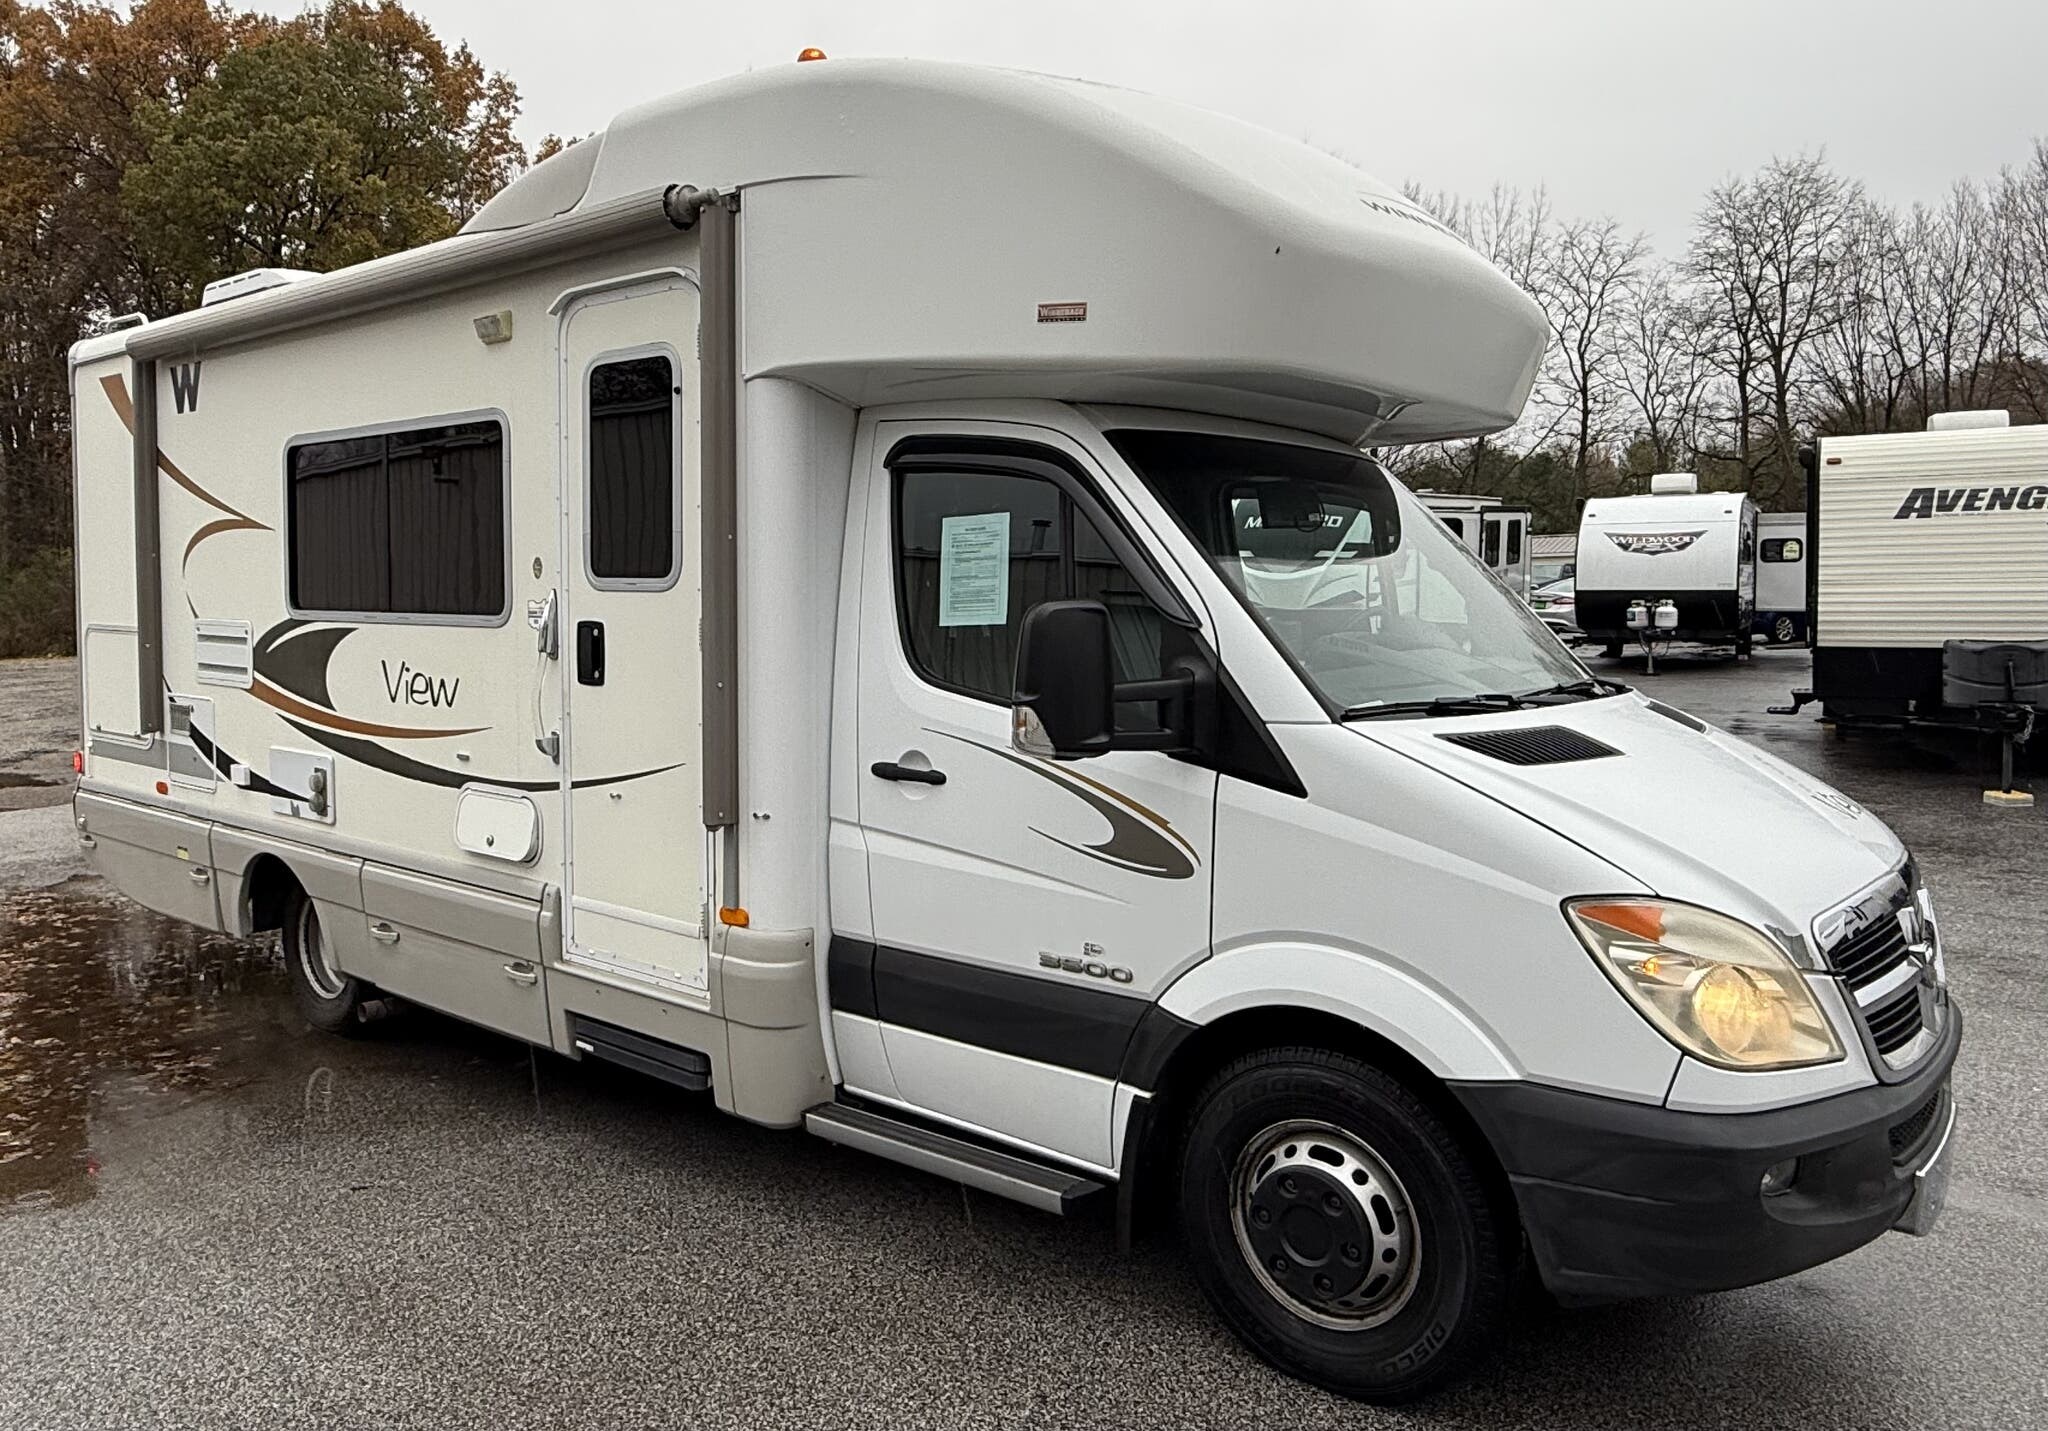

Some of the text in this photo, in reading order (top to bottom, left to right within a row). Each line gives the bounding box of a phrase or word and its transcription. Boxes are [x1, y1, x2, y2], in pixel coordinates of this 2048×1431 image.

[170, 361, 201, 414] W
[1893, 486, 2048, 519] AVENG
[1611, 535, 1698, 545] WILDWOOD
[381, 660, 459, 708] View
[1039, 951, 1134, 984] 3500
